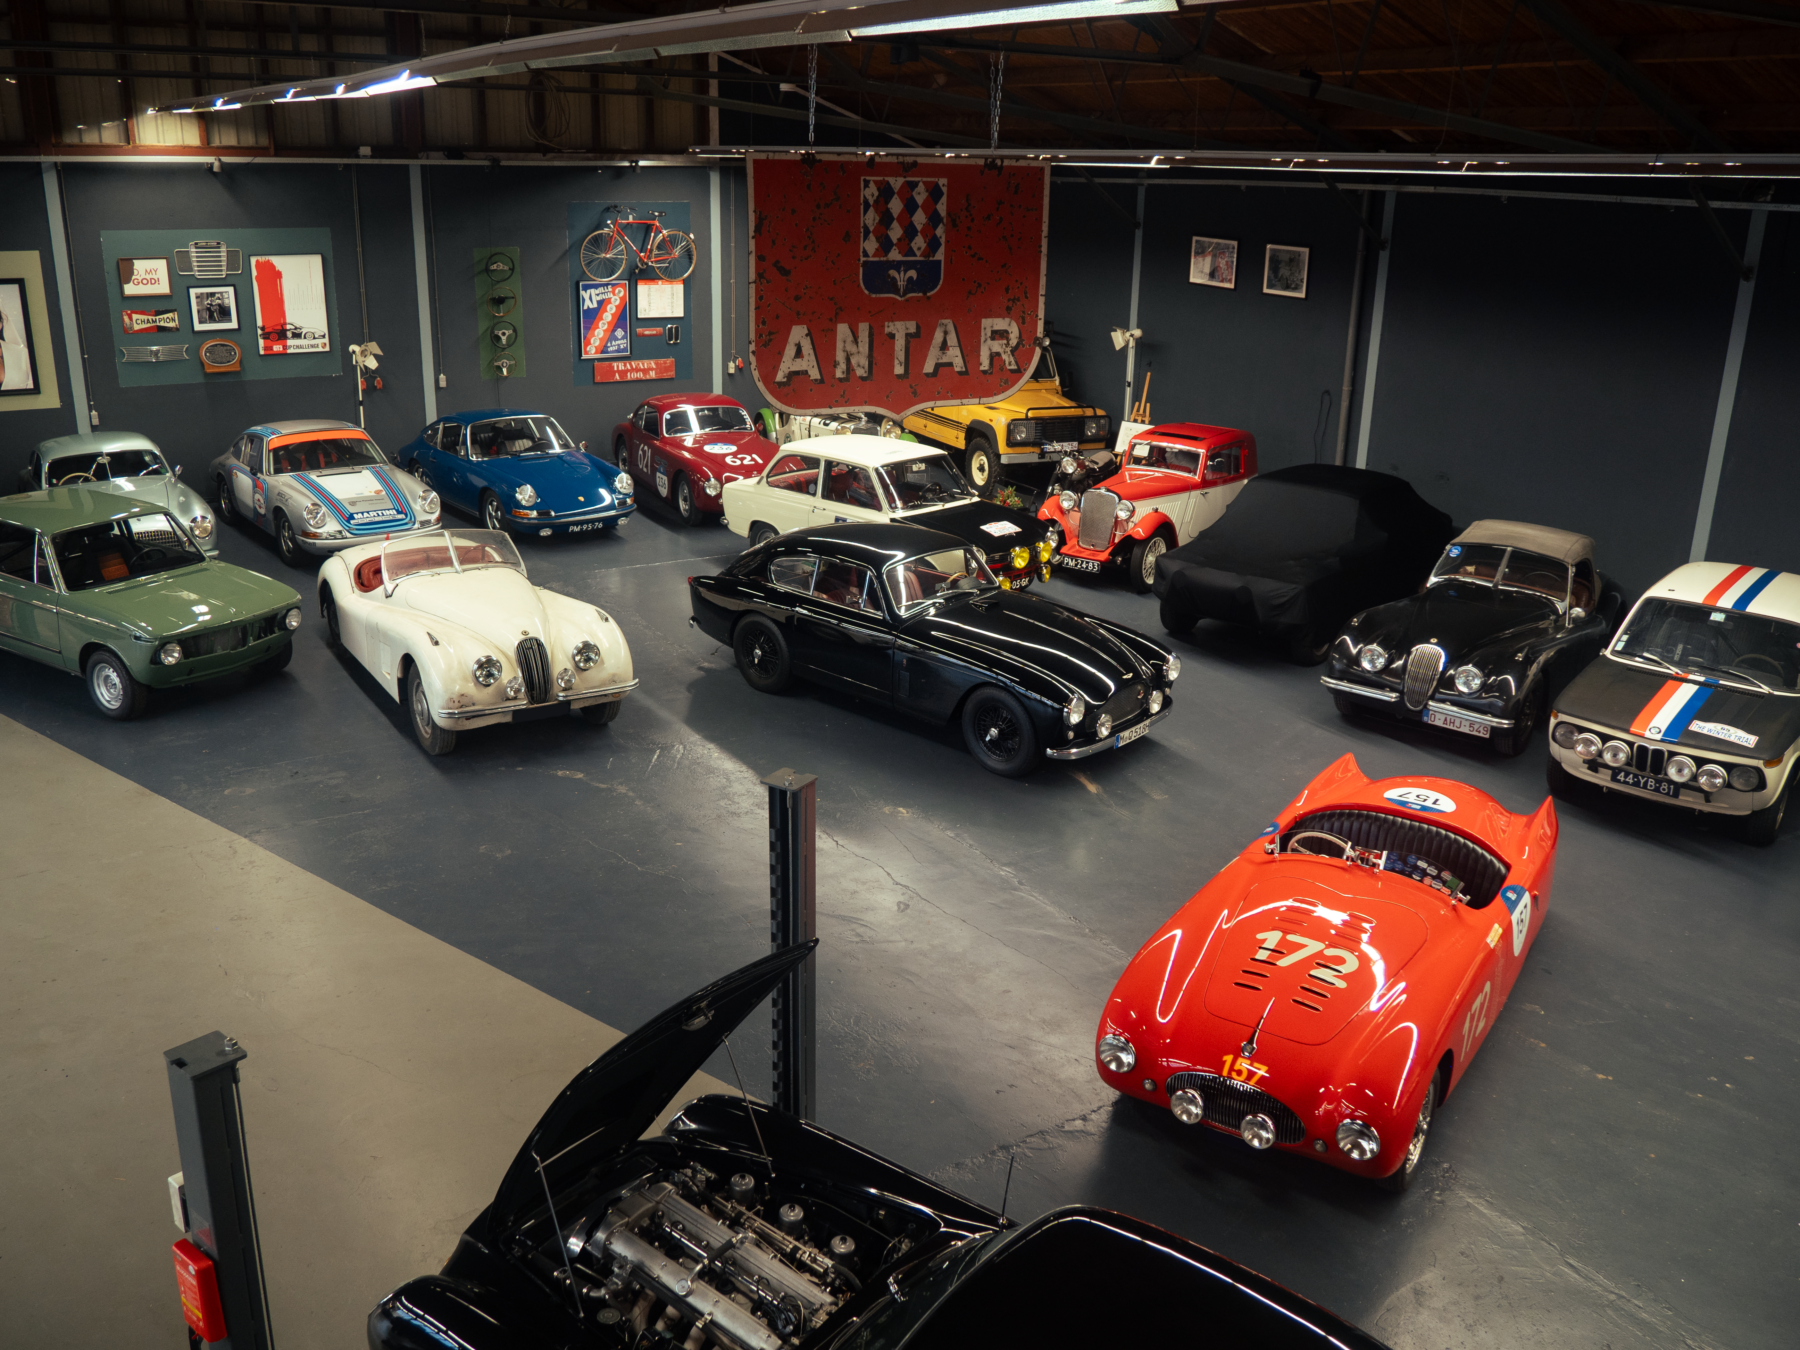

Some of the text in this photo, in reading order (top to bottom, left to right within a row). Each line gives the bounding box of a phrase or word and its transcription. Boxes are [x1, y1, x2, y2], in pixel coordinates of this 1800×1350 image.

[145, 268, 158, 276] MY
[132, 278, 160, 286] GOD!
[581, 288, 597, 310] XI
[135, 316, 176, 326] CHAMPION
[774, 317, 1024, 385] ANTAR
[612, 360, 656, 371] TRAVAUX
[614, 372, 620, 380] A
[627, 371, 643, 380] 100
[638, 443, 651, 475] 621
[724, 453, 763, 466] 621
[353, 509, 398, 519] MARTINI
[568, 521, 603, 533] PM-95-76
[1064, 557, 1099, 571] PM-24-83
[1693, 723, 1706, 732] THE
[1707, 727, 1732, 739] WINTER
[1734, 735, 1752, 746] TRIAL
[1616, 771, 1674, 796] 44-YB-81
[1397, 791, 1441, 806] 157
[1516, 902, 1528, 940] 157
[1256, 930, 1359, 989] 172
[1459, 980, 1491, 1062] 172
[1221, 1054, 1269, 1086] 157
